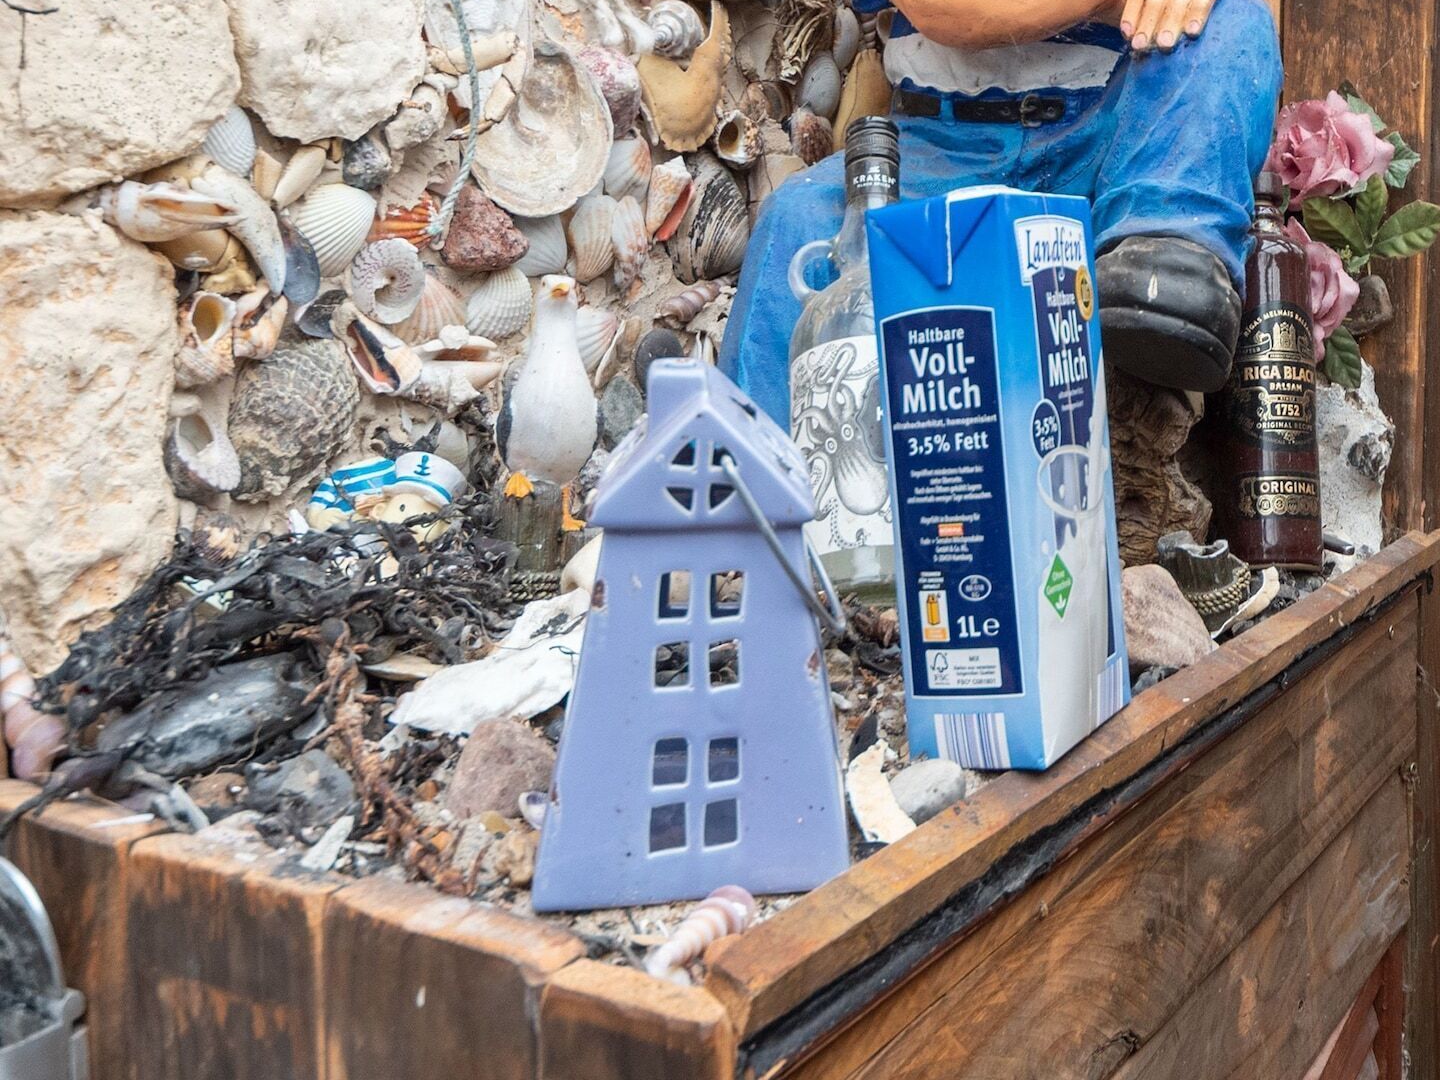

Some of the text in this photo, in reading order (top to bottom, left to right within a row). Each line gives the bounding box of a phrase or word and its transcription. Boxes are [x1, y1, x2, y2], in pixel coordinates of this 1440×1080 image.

[908, 327, 965, 345] Haltbare
[1048, 309, 1082, 346] Voll-
[909, 343, 975, 378] Voll-
[1048, 349, 1088, 388] Milch
[1243, 365, 1281, 380] RIGA
[903, 376, 982, 414] Milch
[1269, 382, 1303, 392] BALSAM
[1274, 403, 1300, 416] 1752
[1256, 421, 1293, 429] ORIGINAL
[908, 430, 989, 456] 3,5% Fett
[1040, 435, 1055, 452] Fett
[1260, 480, 1316, 495] ORIGINAL
